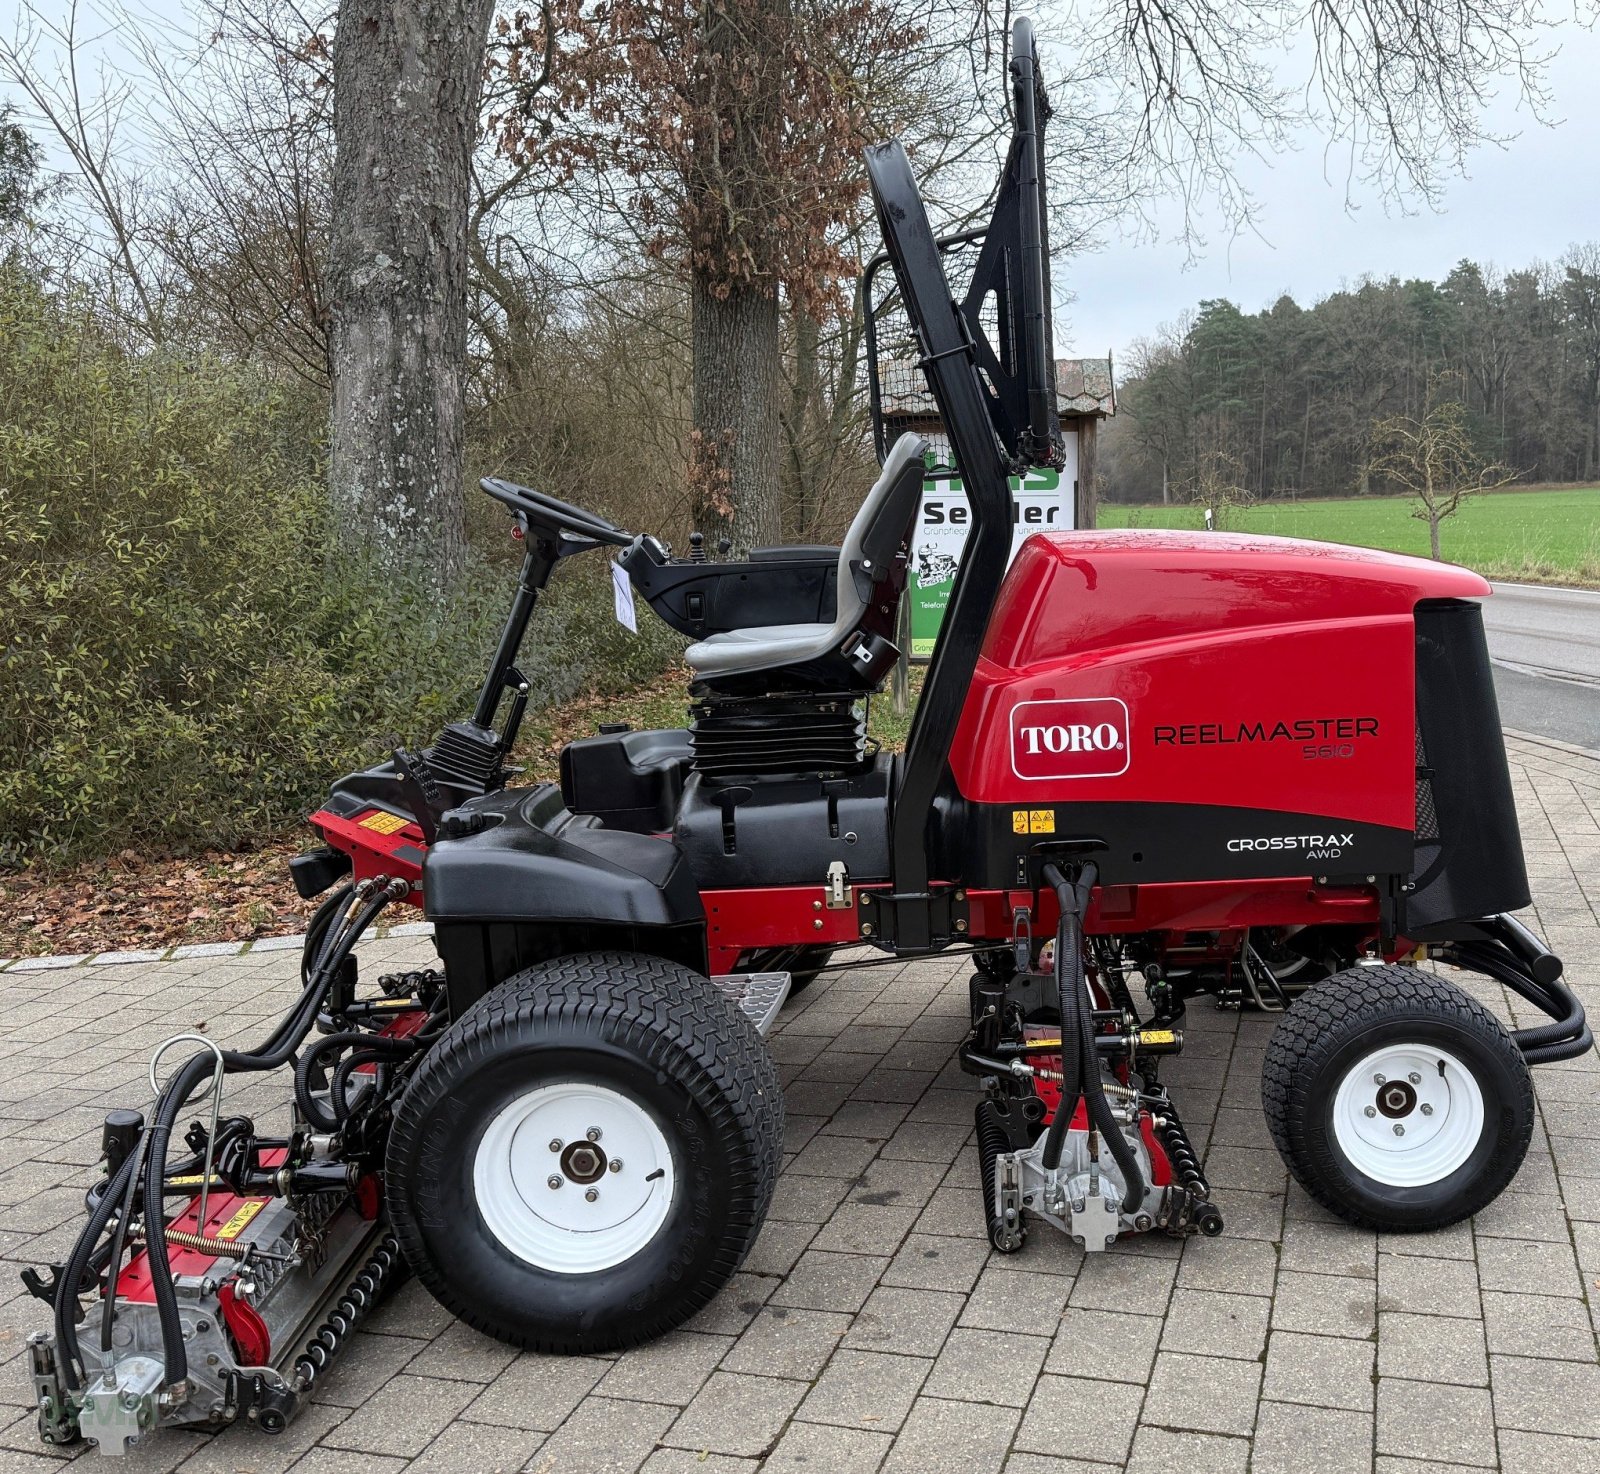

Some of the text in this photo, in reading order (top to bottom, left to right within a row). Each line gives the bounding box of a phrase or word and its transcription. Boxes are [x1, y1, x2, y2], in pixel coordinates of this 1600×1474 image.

[1154, 718, 1379, 746] REELMASTER
[1303, 743, 1354, 759] 5610
[1226, 833, 1354, 852] CROSSTRAX
[1306, 848, 1341, 860] AWD
